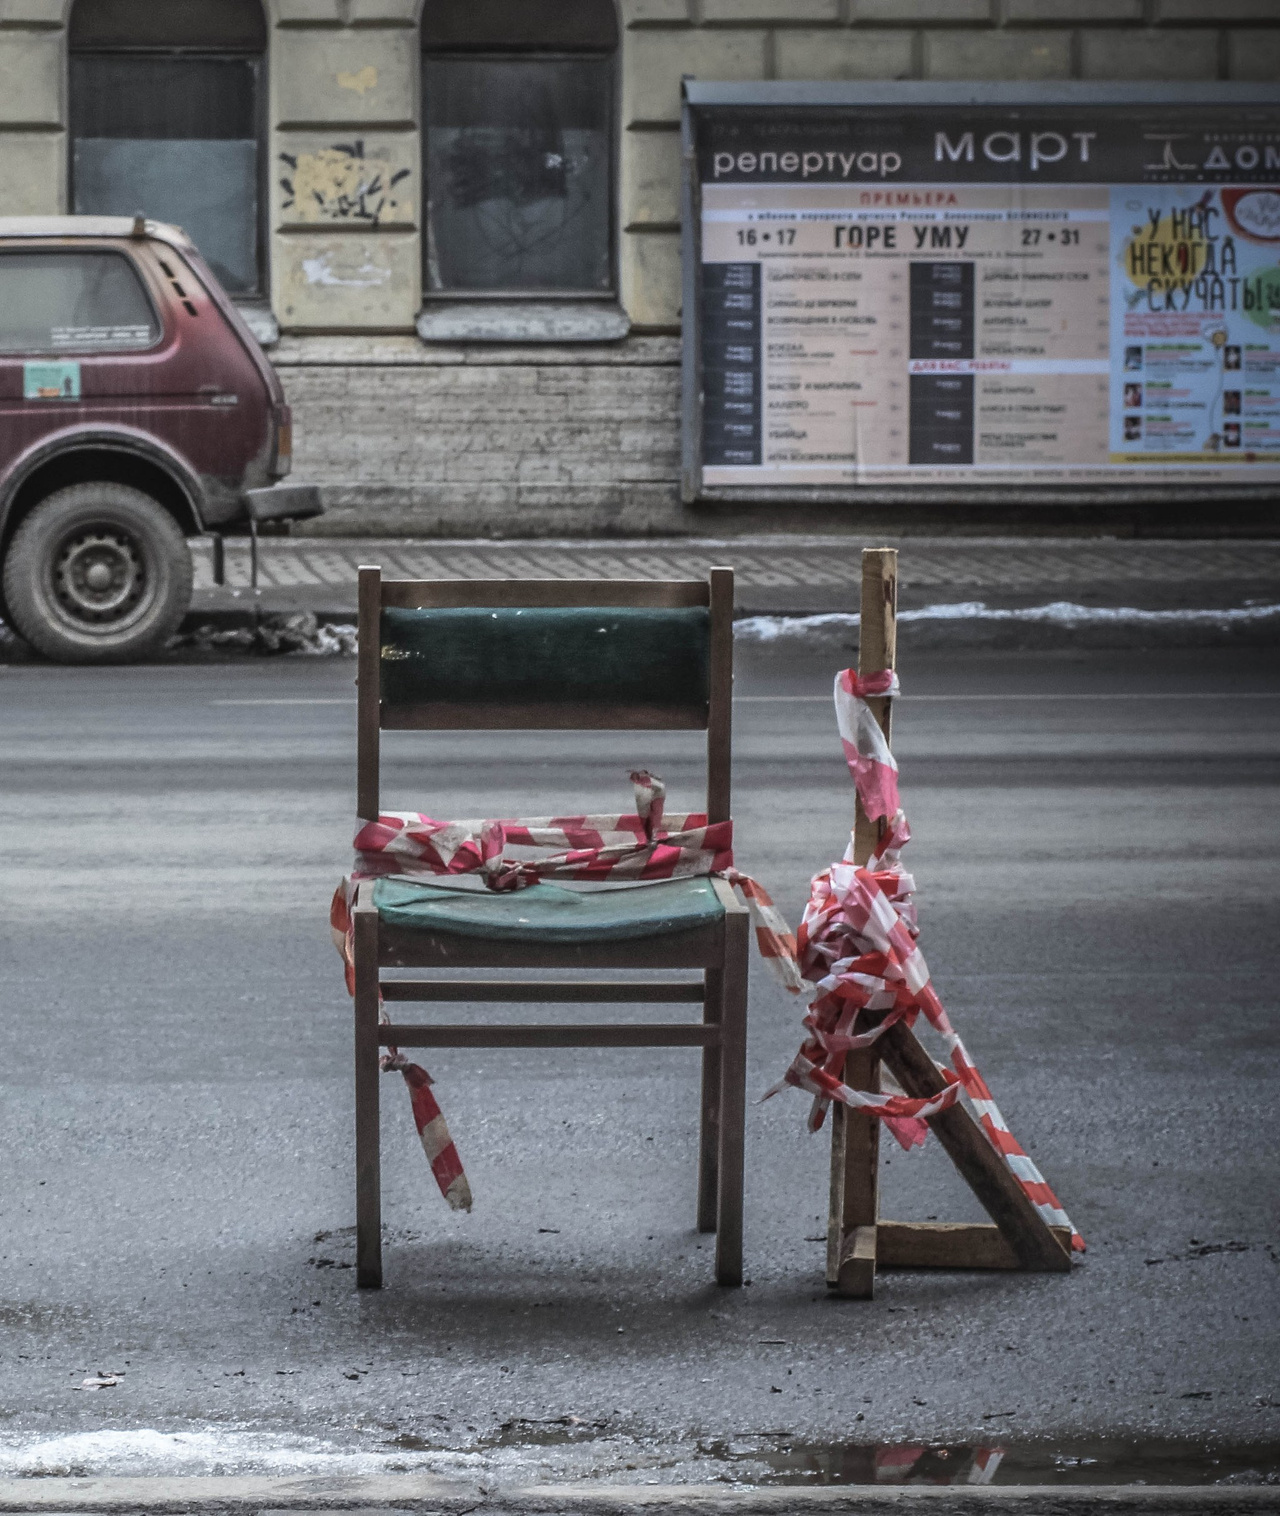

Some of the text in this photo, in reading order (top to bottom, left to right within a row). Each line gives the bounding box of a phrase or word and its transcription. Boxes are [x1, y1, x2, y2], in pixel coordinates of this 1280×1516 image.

[713, 150, 903, 178] репертуар
[934, 130, 1098, 172] март
[859, 191, 959, 207] ПРЕМЬЕРА
[1147, 206, 1161, 241] У
[1171, 204, 1220, 241] НАС
[737, 228, 797, 246] 16 17
[834, 225, 970, 249] ГОРЕ УМУ
[1021, 228, 1080, 246] 27 31
[1130, 236, 1237, 277] НЕКОГДА
[1146, 276, 1263, 313] СКУЧАТЬ!
